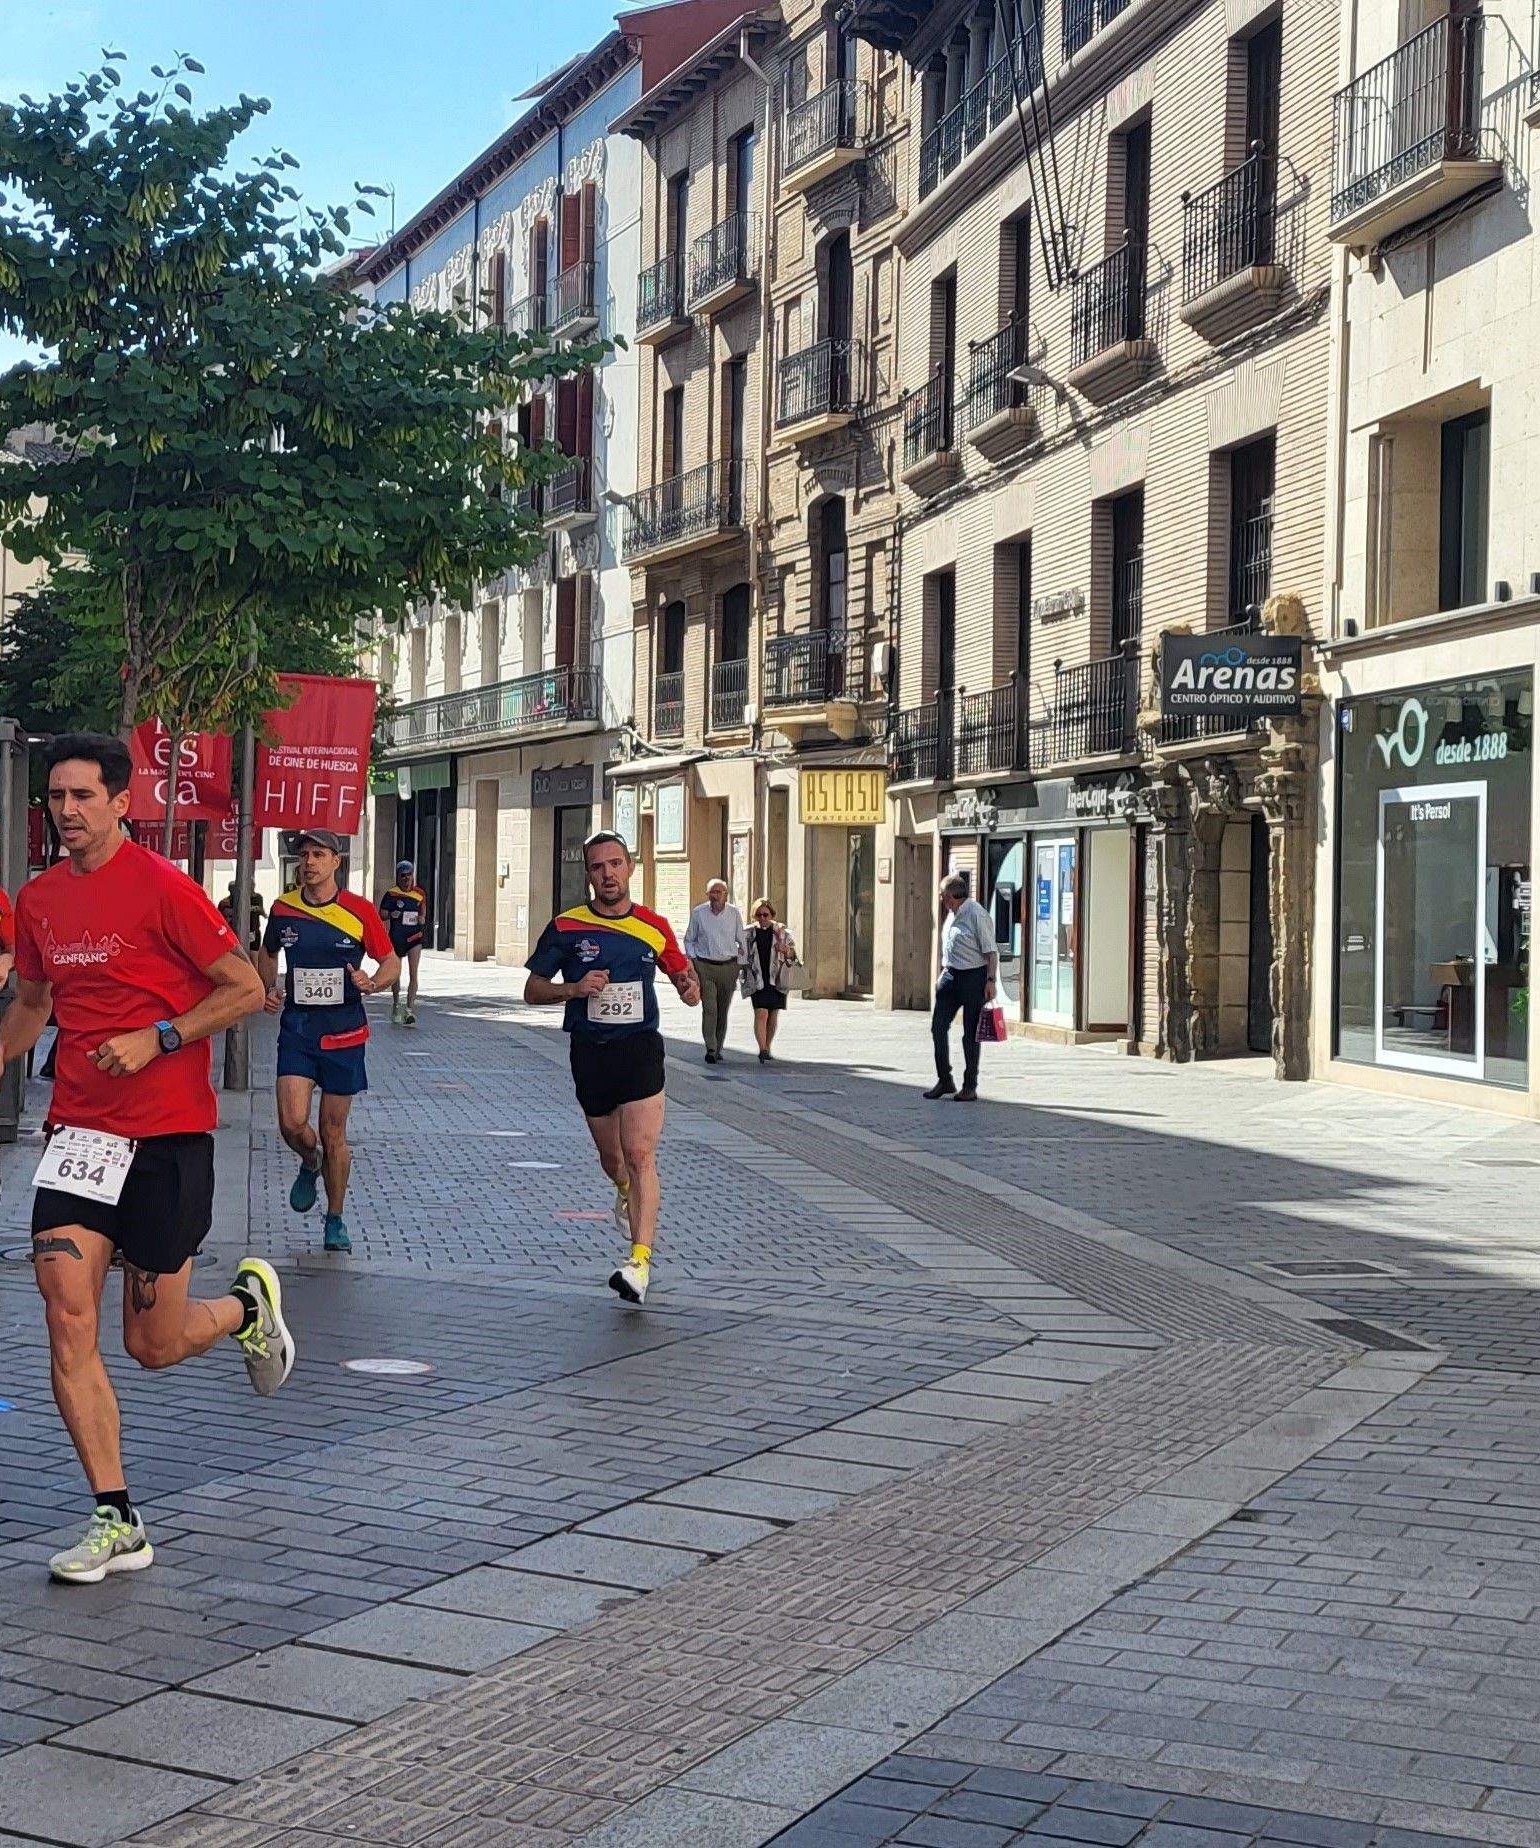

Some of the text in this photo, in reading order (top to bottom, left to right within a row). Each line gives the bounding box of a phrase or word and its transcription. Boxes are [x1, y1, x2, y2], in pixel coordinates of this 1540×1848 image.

[1246, 655, 1292, 665] desde 1888
[1170, 658, 1296, 690] Arenas
[1170, 691, 1296, 704] CENTRO ÓPTICO Y AUDITIVO
[302, 747, 359, 756] INTERNACIONAL
[1436, 731, 1507, 765] desde 1888
[268, 756, 359, 773] DE CINE DE HUESCA
[264, 779, 357, 819] HIFF
[806, 772, 879, 812] ASCASO
[1411, 801, 1451, 821] It's Persol
[52, 952, 109, 967] CANFRANC
[304, 986, 333, 999] 340
[600, 1002, 633, 1017] 292
[57, 1158, 106, 1187] 634
